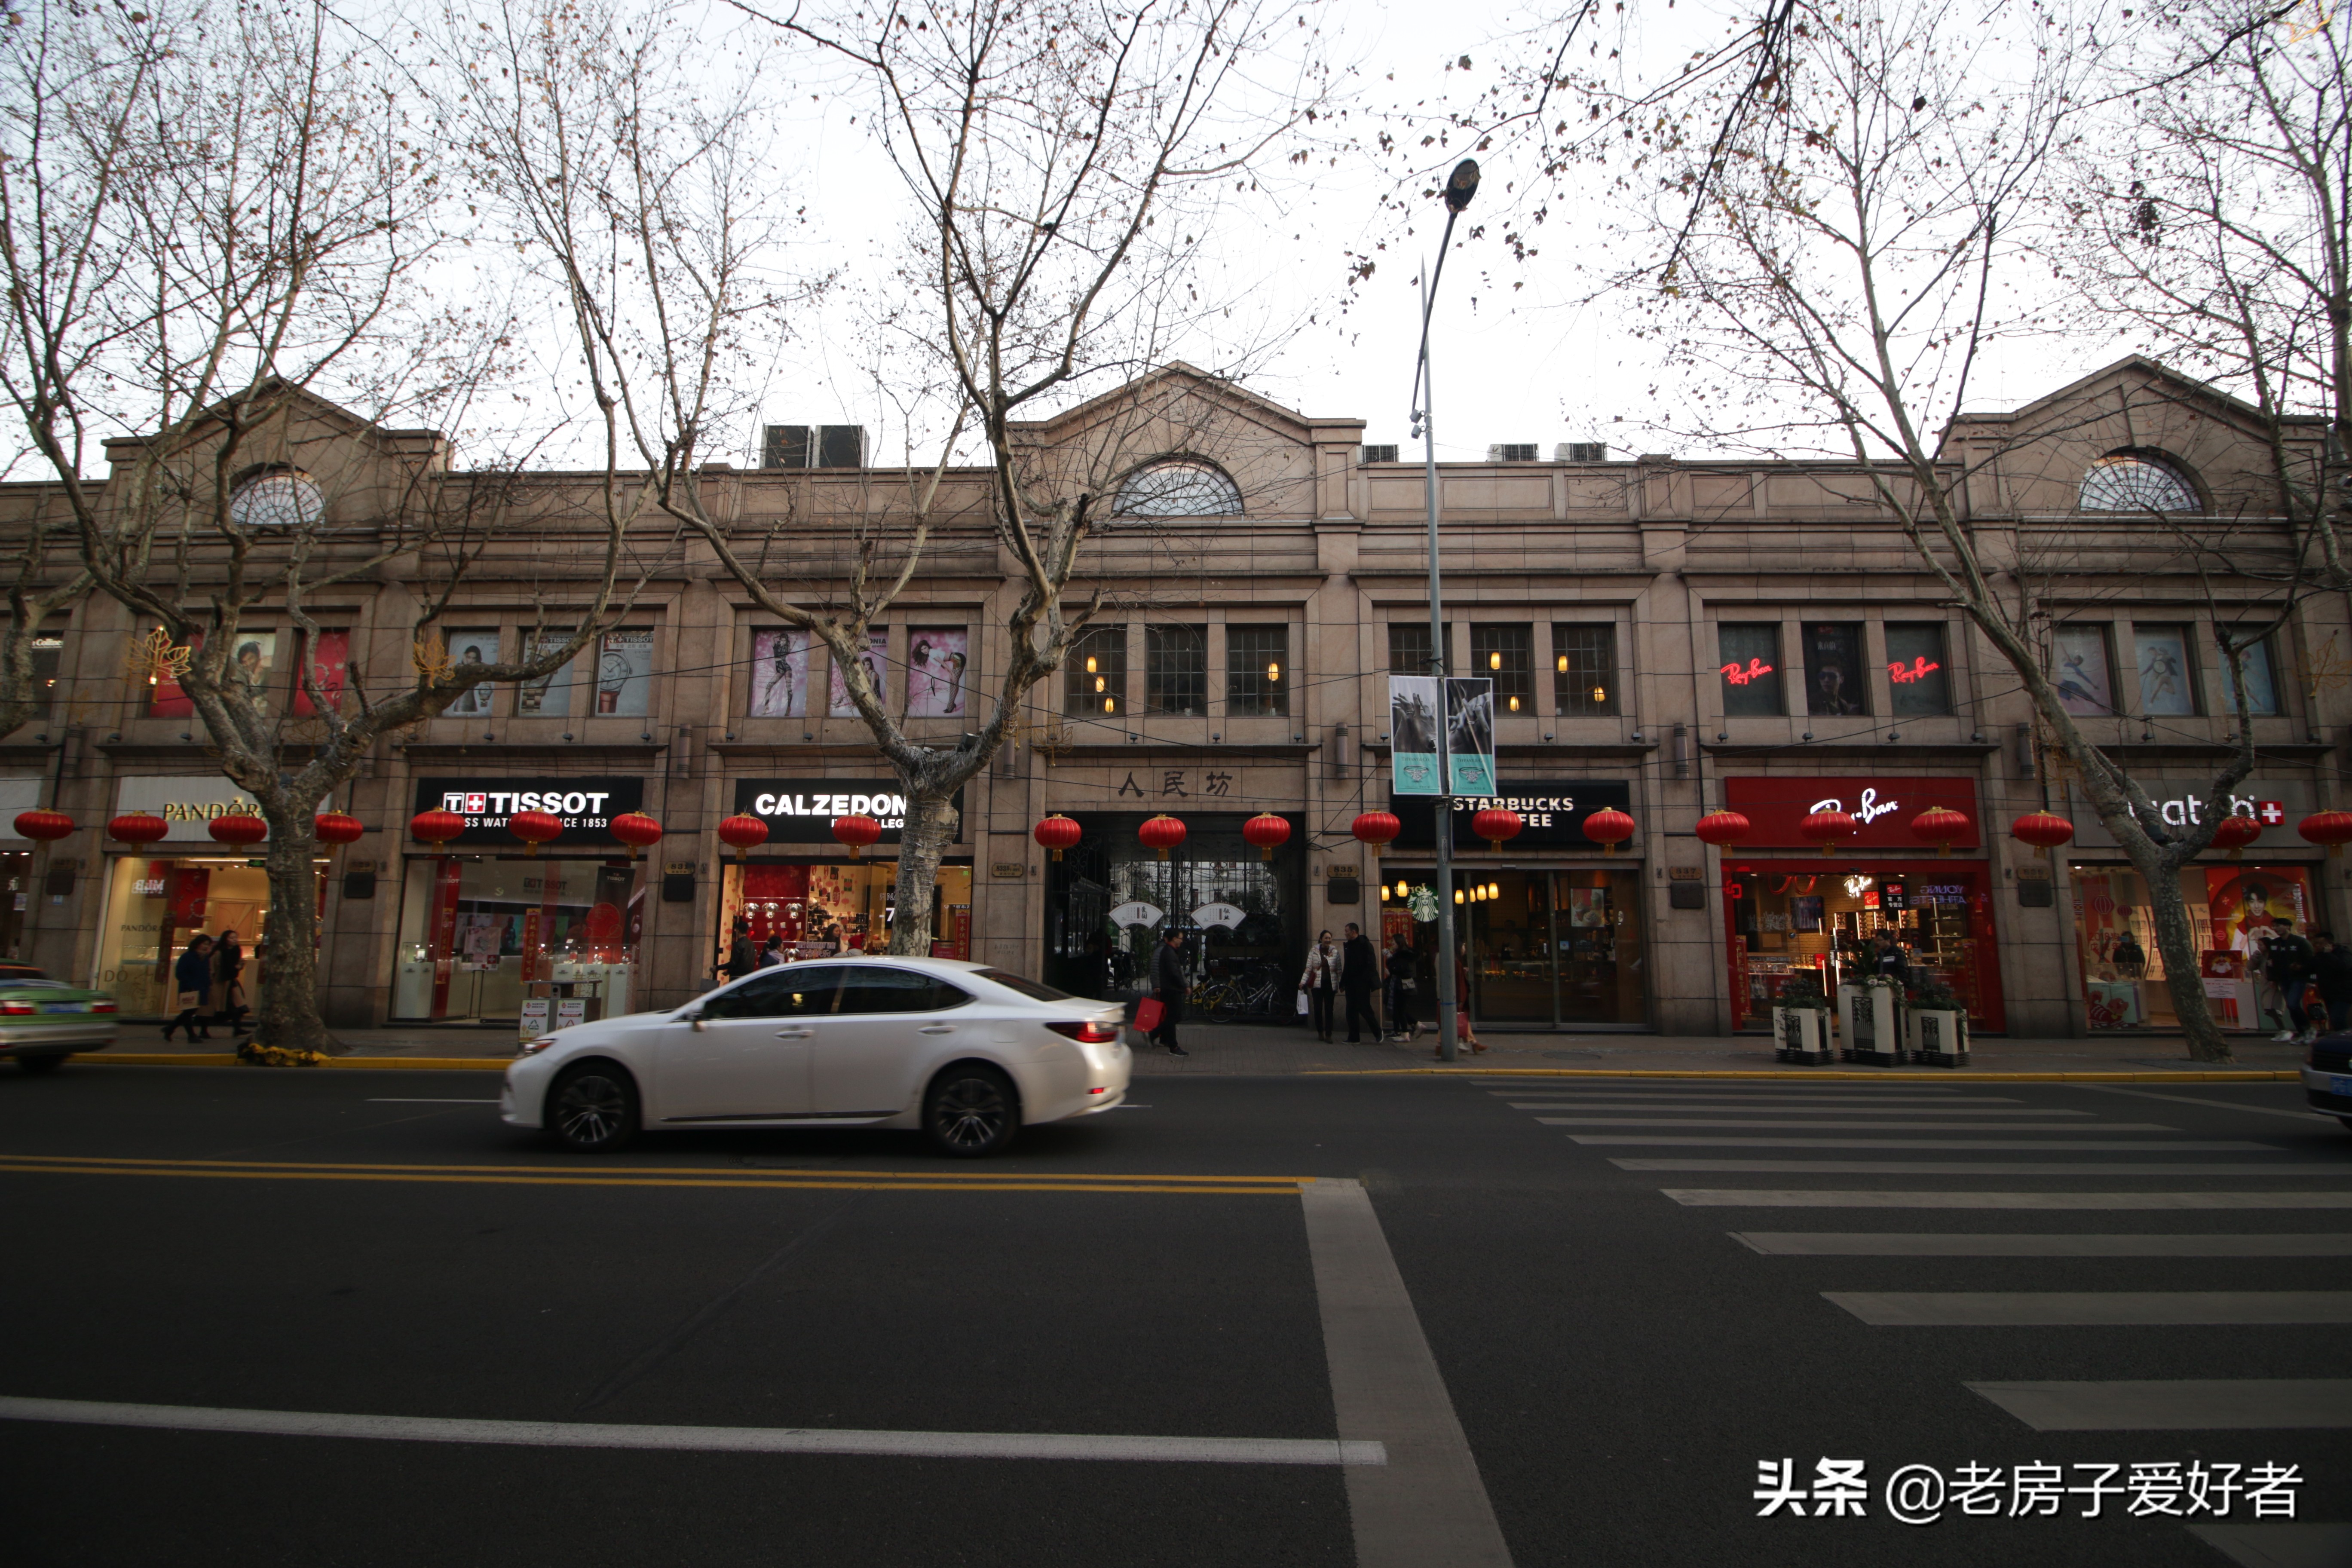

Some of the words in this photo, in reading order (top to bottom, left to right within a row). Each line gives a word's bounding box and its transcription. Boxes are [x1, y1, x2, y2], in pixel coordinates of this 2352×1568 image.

[1721, 658, 1772, 684] Ray-Ban
[1888, 656, 1939, 683] Ray-Ban
[1118, 771, 1233, 797] 人民坊
[163, 801, 261, 820] PANDOR
[488, 792, 609, 813] TISSOT
[756, 794, 906, 815] CALZEDON
[1453, 798, 1574, 811] STARBUCKS
[582, 818, 607, 827] 1853
[537, 879, 567, 890] TSSOT
[1844, 876, 1872, 897] Ray-Ban
[1142, 906, 1147, 919] 爱国
